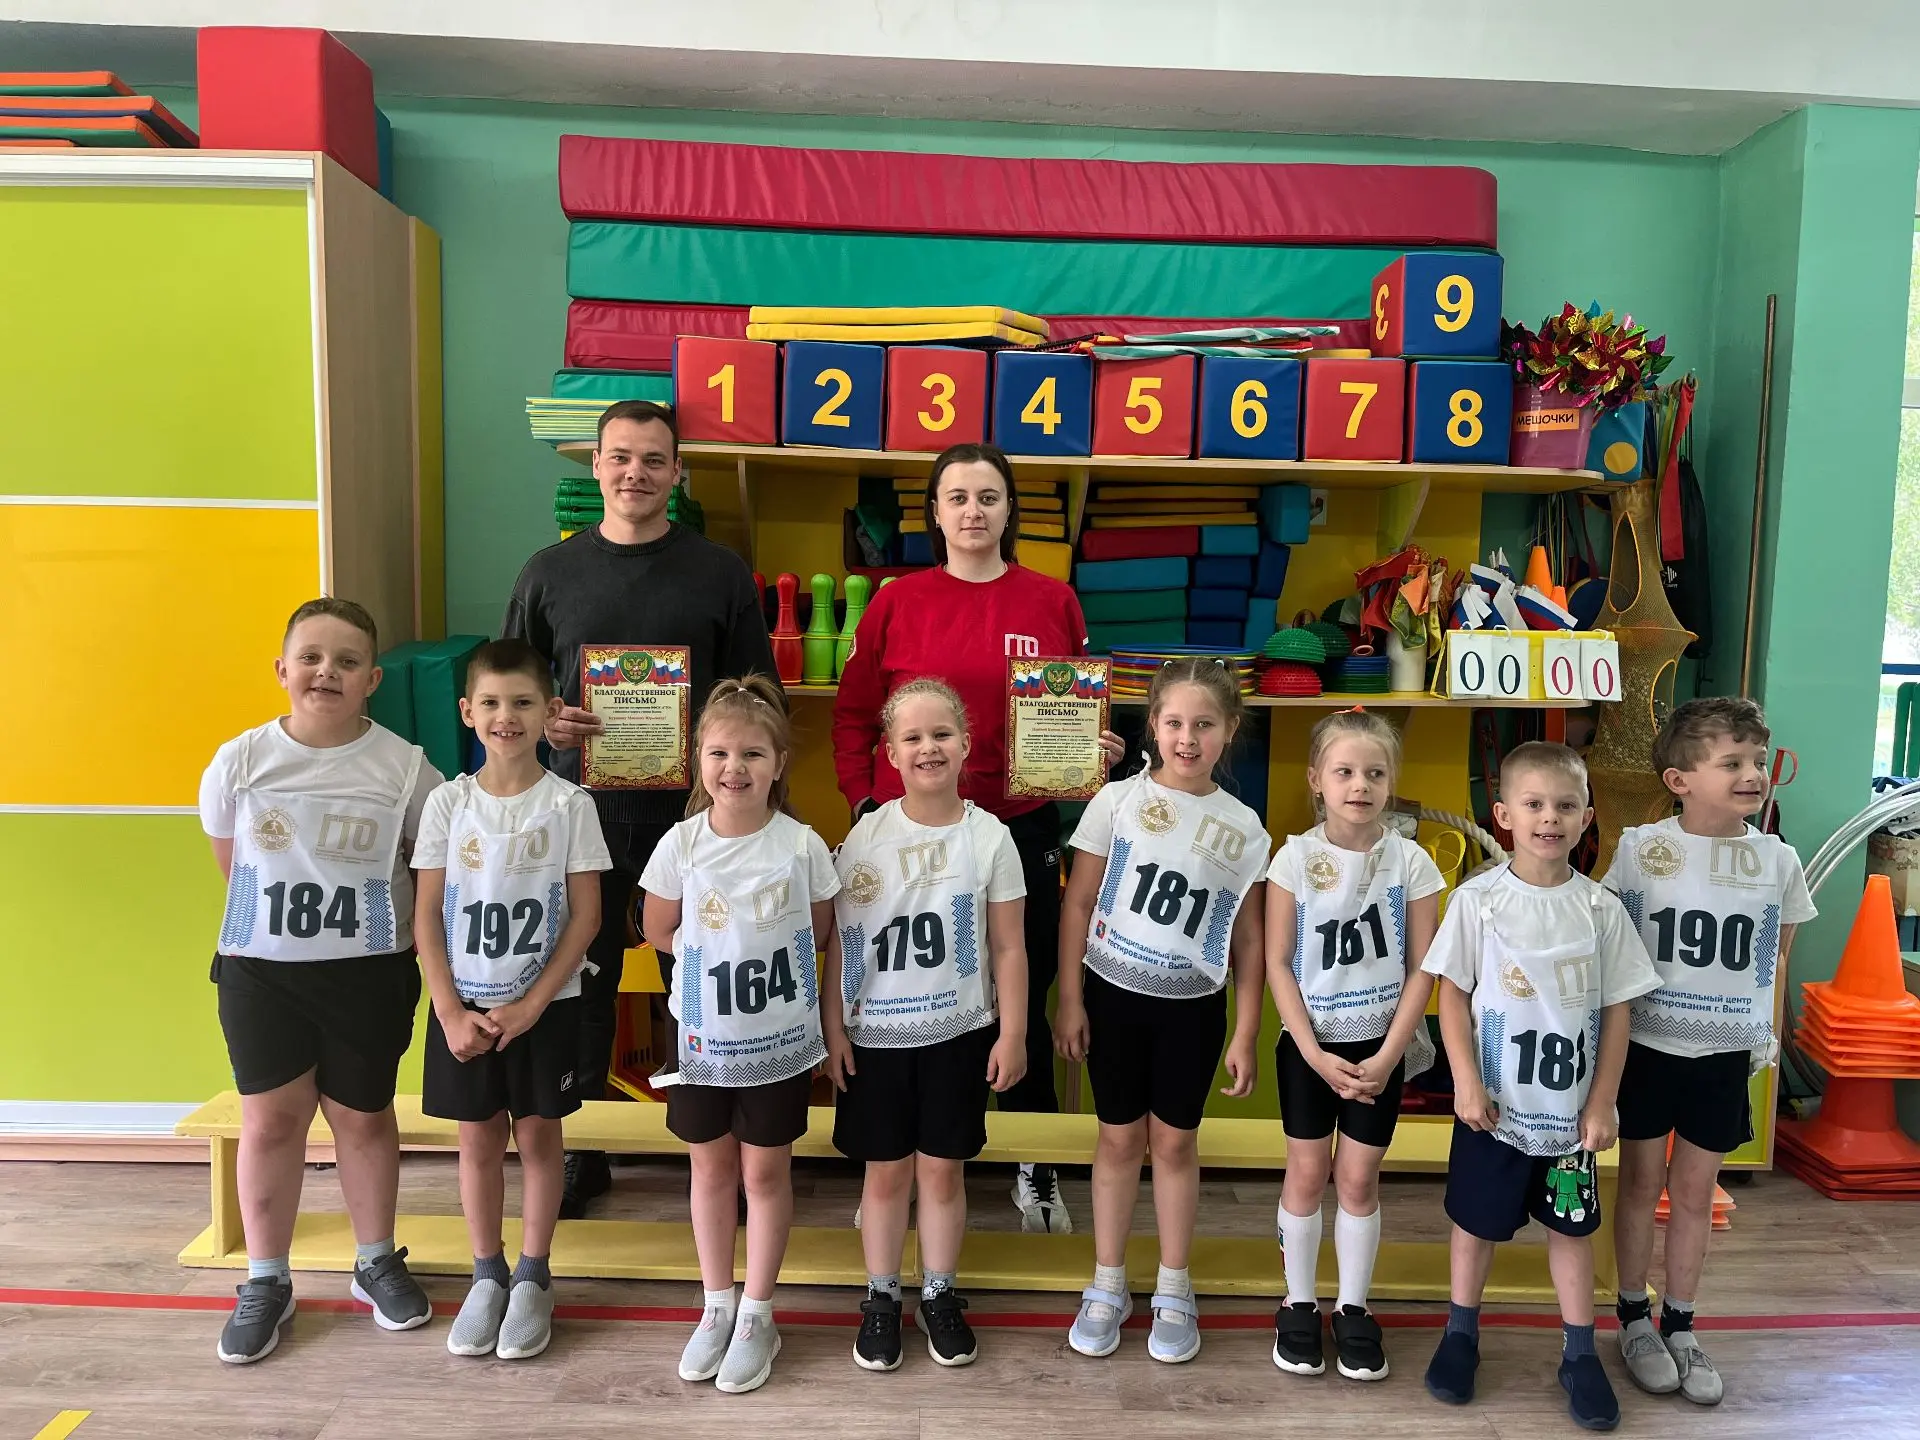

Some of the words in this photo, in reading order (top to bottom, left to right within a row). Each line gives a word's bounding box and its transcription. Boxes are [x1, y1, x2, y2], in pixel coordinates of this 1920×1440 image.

[1433, 274, 1475, 333] 9
[706, 364, 735, 423] 1
[811, 368, 853, 428] 2
[917, 373, 957, 432] 3
[1020, 377, 1062, 435] 4
[1123, 377, 1163, 435] 5
[1230, 379, 1268, 439] 6
[1339, 382, 1378, 439] 7
[1445, 389, 1483, 448] 8
[1516, 413, 1574, 426] МЕШОЧКИ
[1004, 633, 1040, 657] ГТО
[594, 688, 677, 697] БЛАГОДАРСТВЕННОЕ
[613, 697, 657, 705] ПИСЬМО
[1019, 700, 1098, 709] БЛАГОДАРСТВЕННОЕ
[1036, 708, 1079, 717] ПИСЬМО
[316, 813, 380, 852] ГТО
[1194, 813, 1247, 862] ГТО
[897, 838, 947, 881] ГТО
[1709, 837, 1763, 877] ГТО
[263, 881, 360, 938] 184
[1129, 862, 1209, 939] 181
[462, 898, 544, 960] 192
[871, 911, 946, 973] 179
[1110, 928, 1170, 959] Муниципальный
[1648, 906, 1755, 972] 190
[1107, 938, 1159, 966] тестирования
[1168, 961, 1193, 970] Выкса
[454, 977, 513, 989] Муниципальн
[519, 965, 543, 985] Выкса
[707, 946, 798, 1016] 164
[1307, 986, 1377, 1003] Муниципальный
[1378, 981, 1401, 993] центр
[864, 1006, 921, 1016] тестирования
[931, 999, 958, 1011] Выкса
[865, 993, 930, 1007] Муниципальный
[932, 989, 957, 1001] центр
[1310, 999, 1369, 1012] тестирования
[1378, 990, 1401, 1003] Выкса
[1650, 988, 1723, 1003] униципальный
[1725, 996, 1752, 1006] центр
[1722, 1004, 1751, 1014] Выкса
[707, 1031, 781, 1049] Муниципальный
[782, 1023, 805, 1037] центр
[709, 1044, 771, 1058] тестирования
[780, 1033, 806, 1047] Выкса
[1507, 1115, 1569, 1133] тестирования
